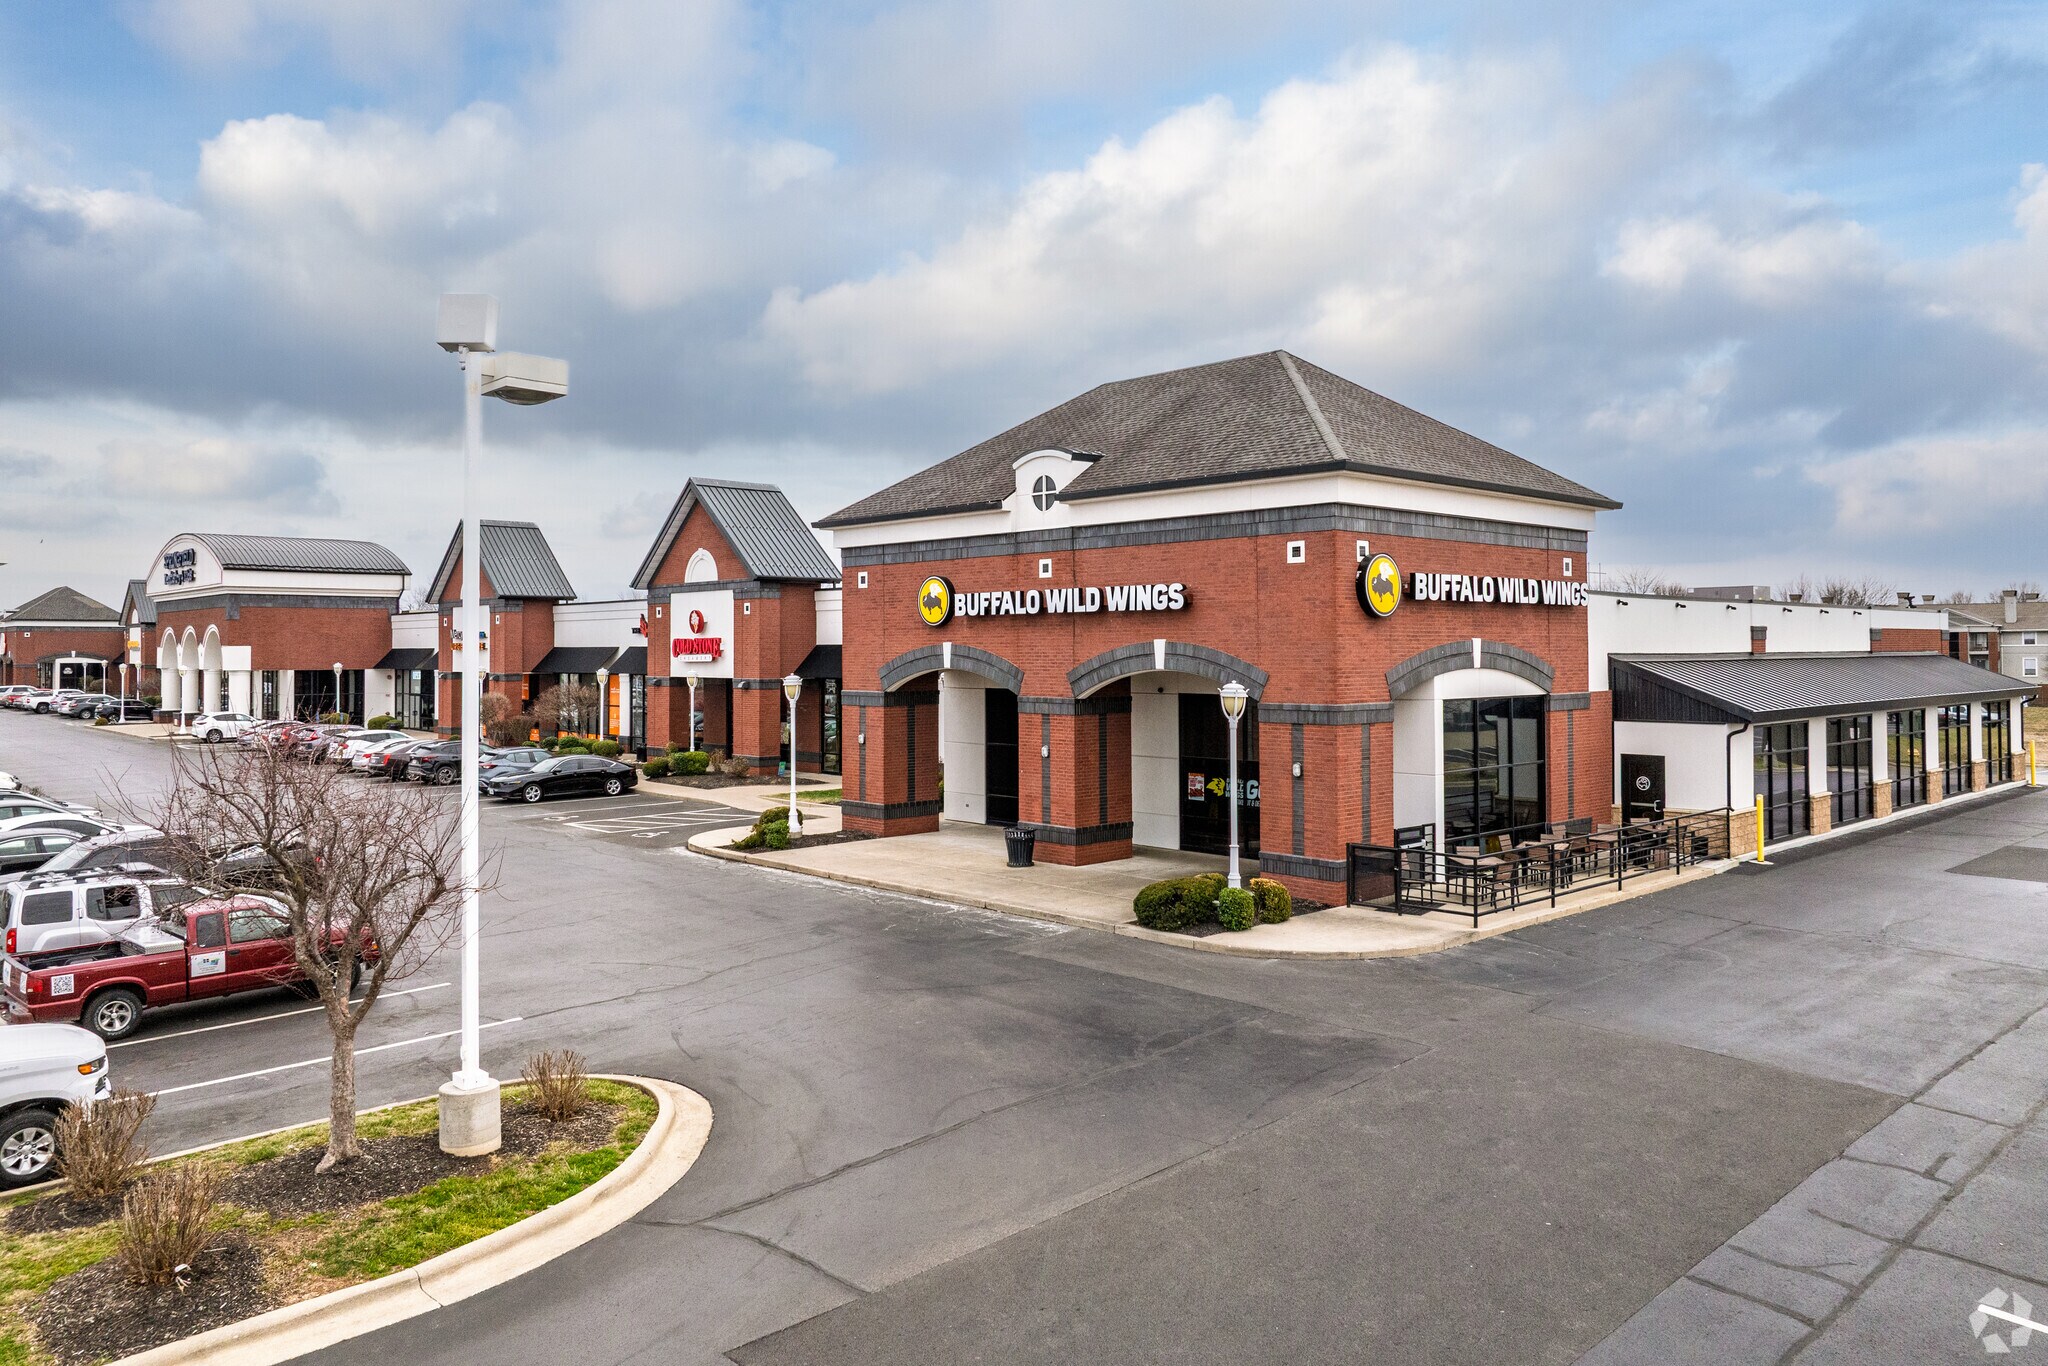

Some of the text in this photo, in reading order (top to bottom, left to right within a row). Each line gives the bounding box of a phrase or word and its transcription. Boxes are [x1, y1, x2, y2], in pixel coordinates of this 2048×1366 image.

[954, 582, 1186, 617] BUFFALO WILD WINGS
[1415, 573, 1589, 607] BUFFALO WILD WINGS
[672, 638, 722, 658] COLD STONE
